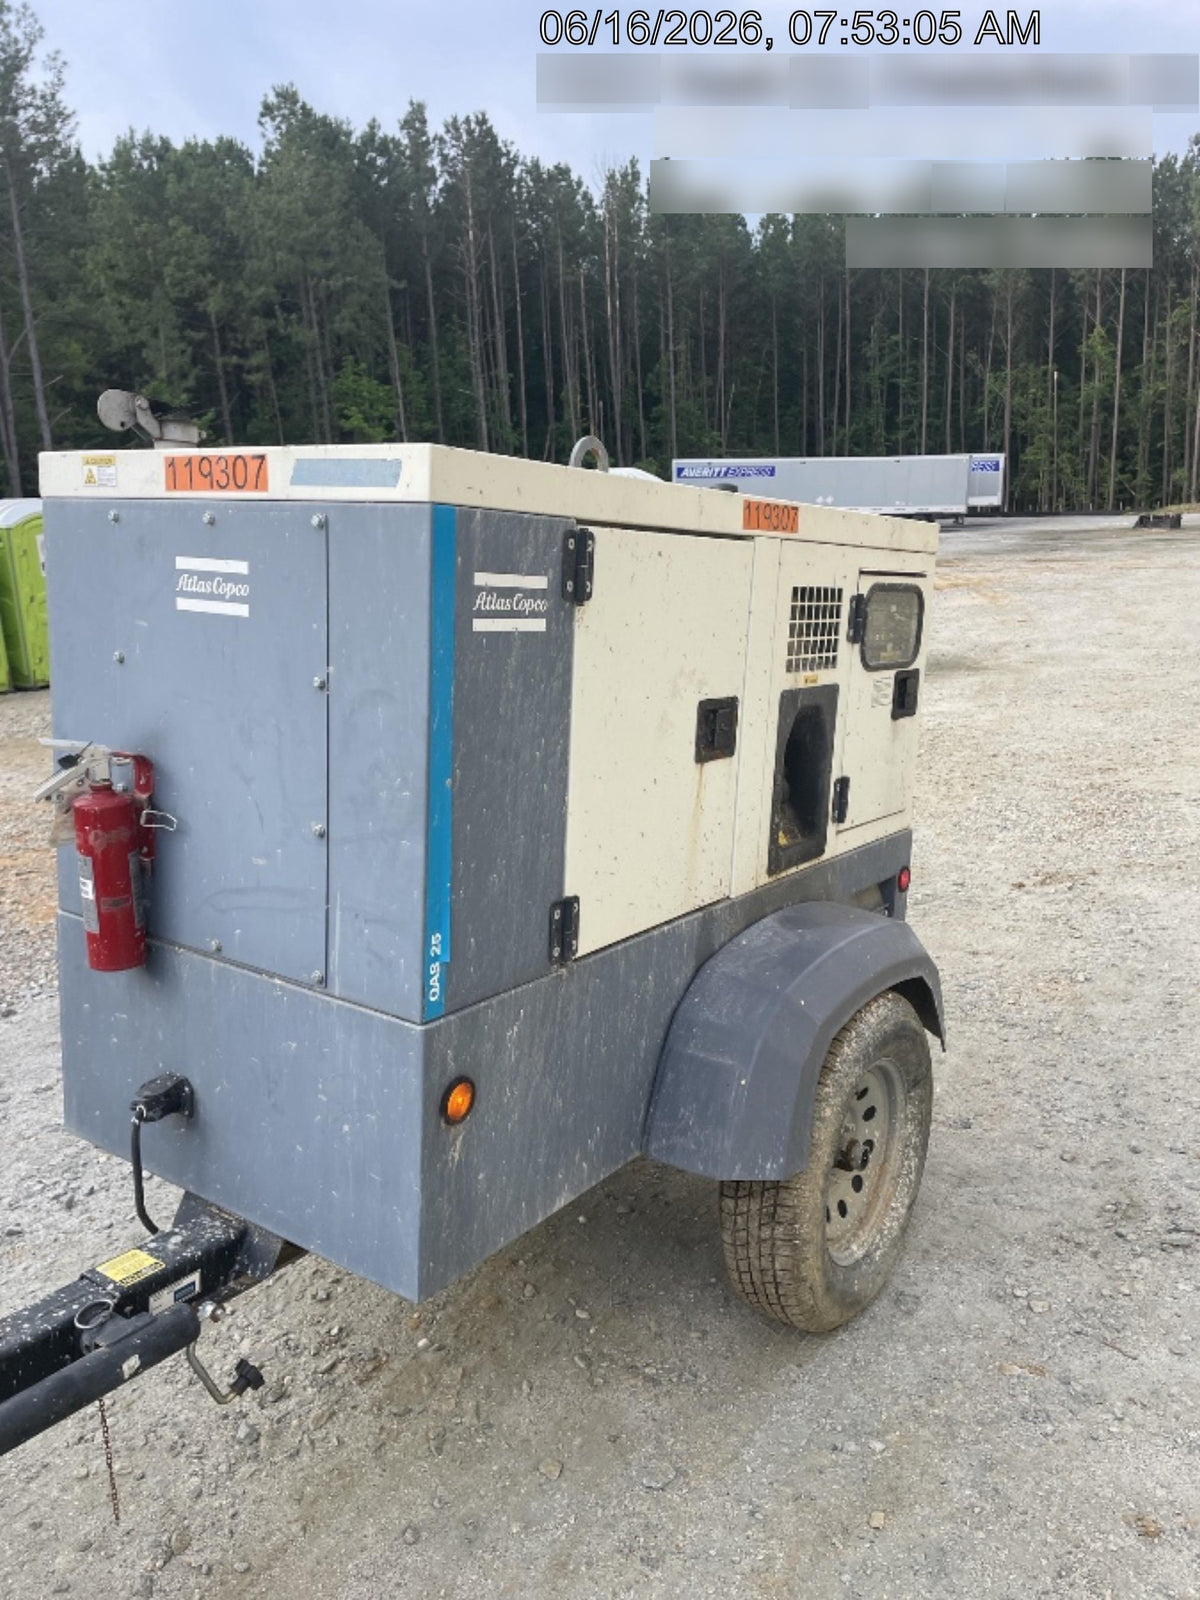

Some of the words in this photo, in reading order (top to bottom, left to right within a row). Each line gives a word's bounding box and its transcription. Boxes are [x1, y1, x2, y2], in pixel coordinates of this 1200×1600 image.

[166, 455, 267, 490] 119307
[681, 466, 726, 478] AVERITT
[745, 500, 799, 533] 119307
[430, 932, 442, 957] 25
